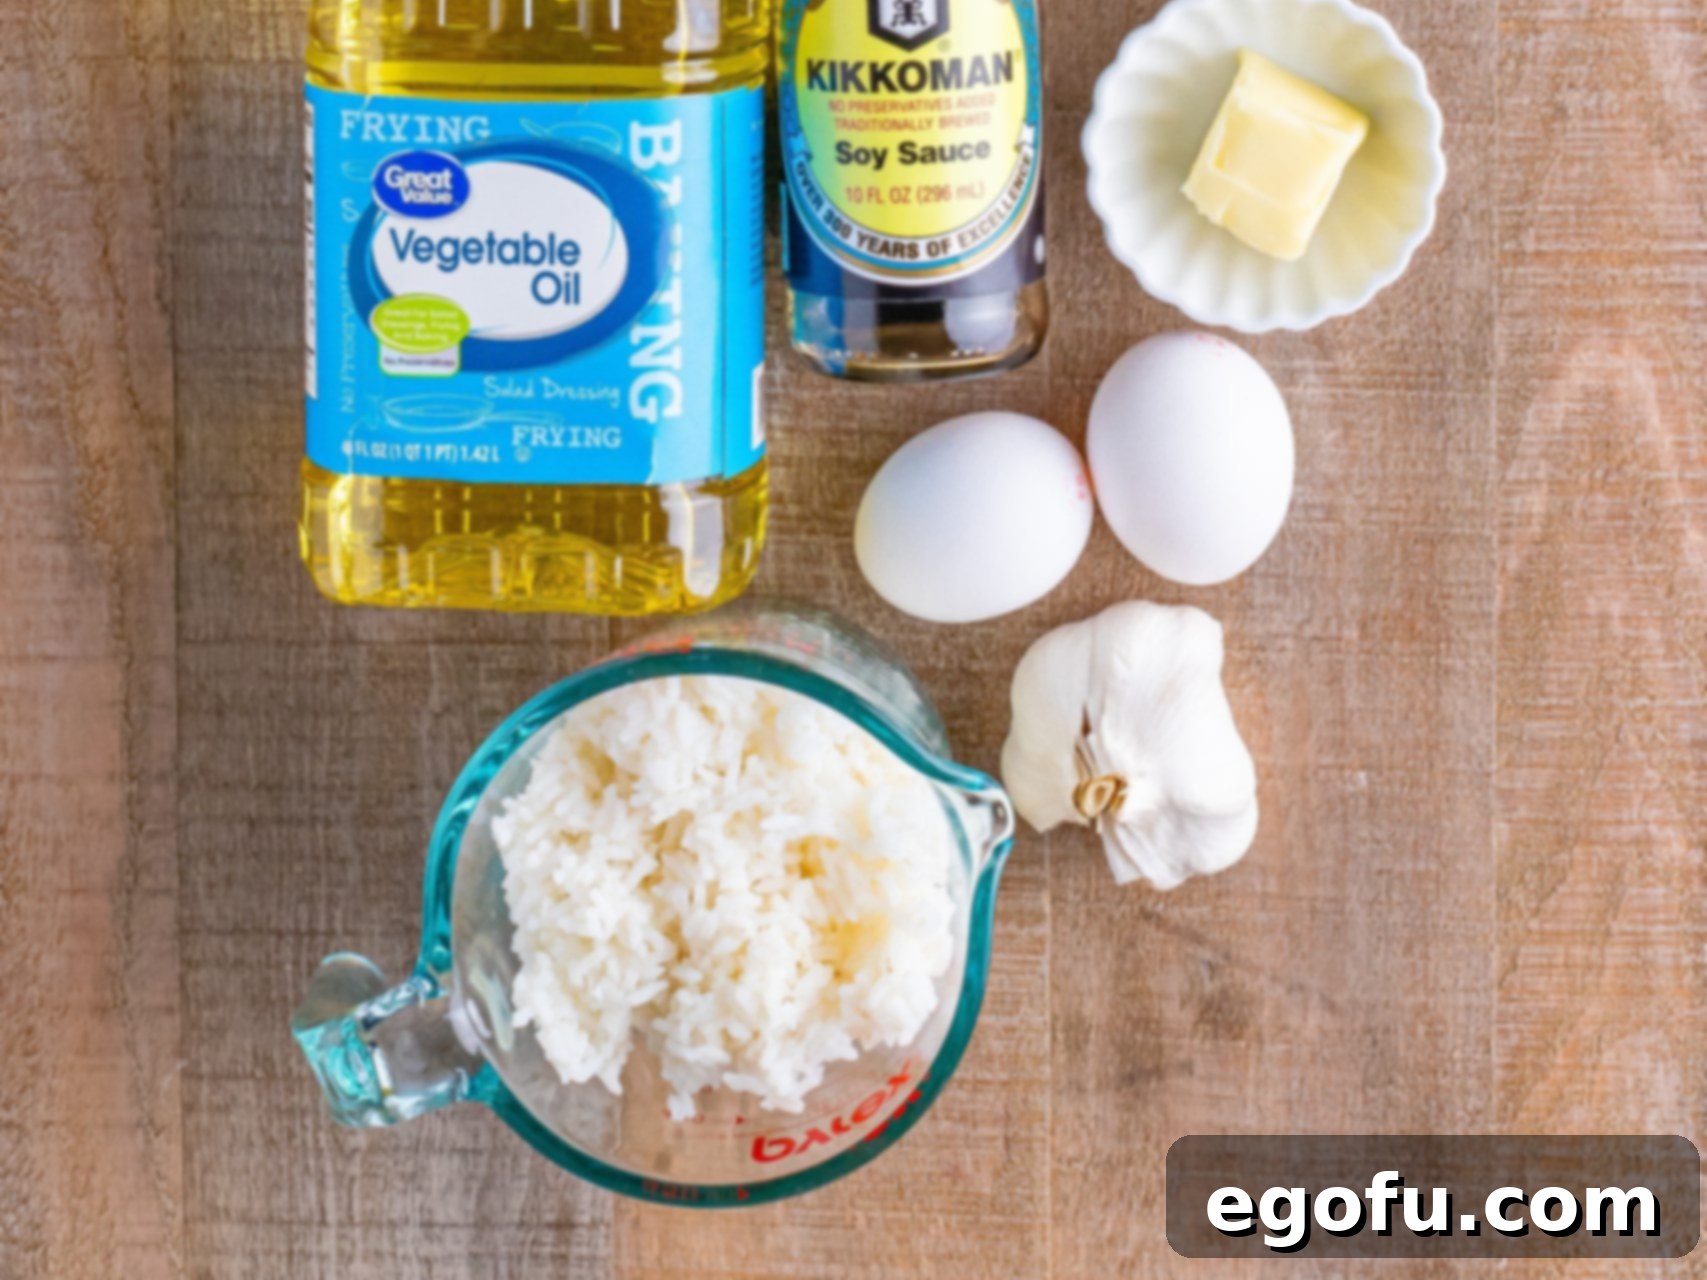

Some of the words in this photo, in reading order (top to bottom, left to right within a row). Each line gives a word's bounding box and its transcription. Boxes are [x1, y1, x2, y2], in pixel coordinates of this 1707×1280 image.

[806, 50, 1014, 94] KIKKOMAN
[849, 96, 952, 114] PRESERVATIVES
[339, 109, 491, 144] FRYING
[834, 115, 933, 132] TRADITIONALLY
[938, 112, 991, 129] BREWED
[835, 140, 888, 170] Soy
[898, 140, 990, 165] Sauce
[384, 165, 453, 191] Great
[400, 186, 454, 204] Value
[845, 187, 863, 204] 10
[867, 187, 884, 204] FL
[889, 186, 911, 204] OZ
[855, 230, 920, 260] YEARS
[925, 239, 952, 258] OF
[957, 154, 1031, 249] EXCELLENCE
[389, 228, 581, 273] Vegetable
[531, 270, 581, 305] Oil
[483, 375, 534, 398] Salad
[540, 376, 620, 409] Dressing
[511, 424, 623, 449] FRYING
